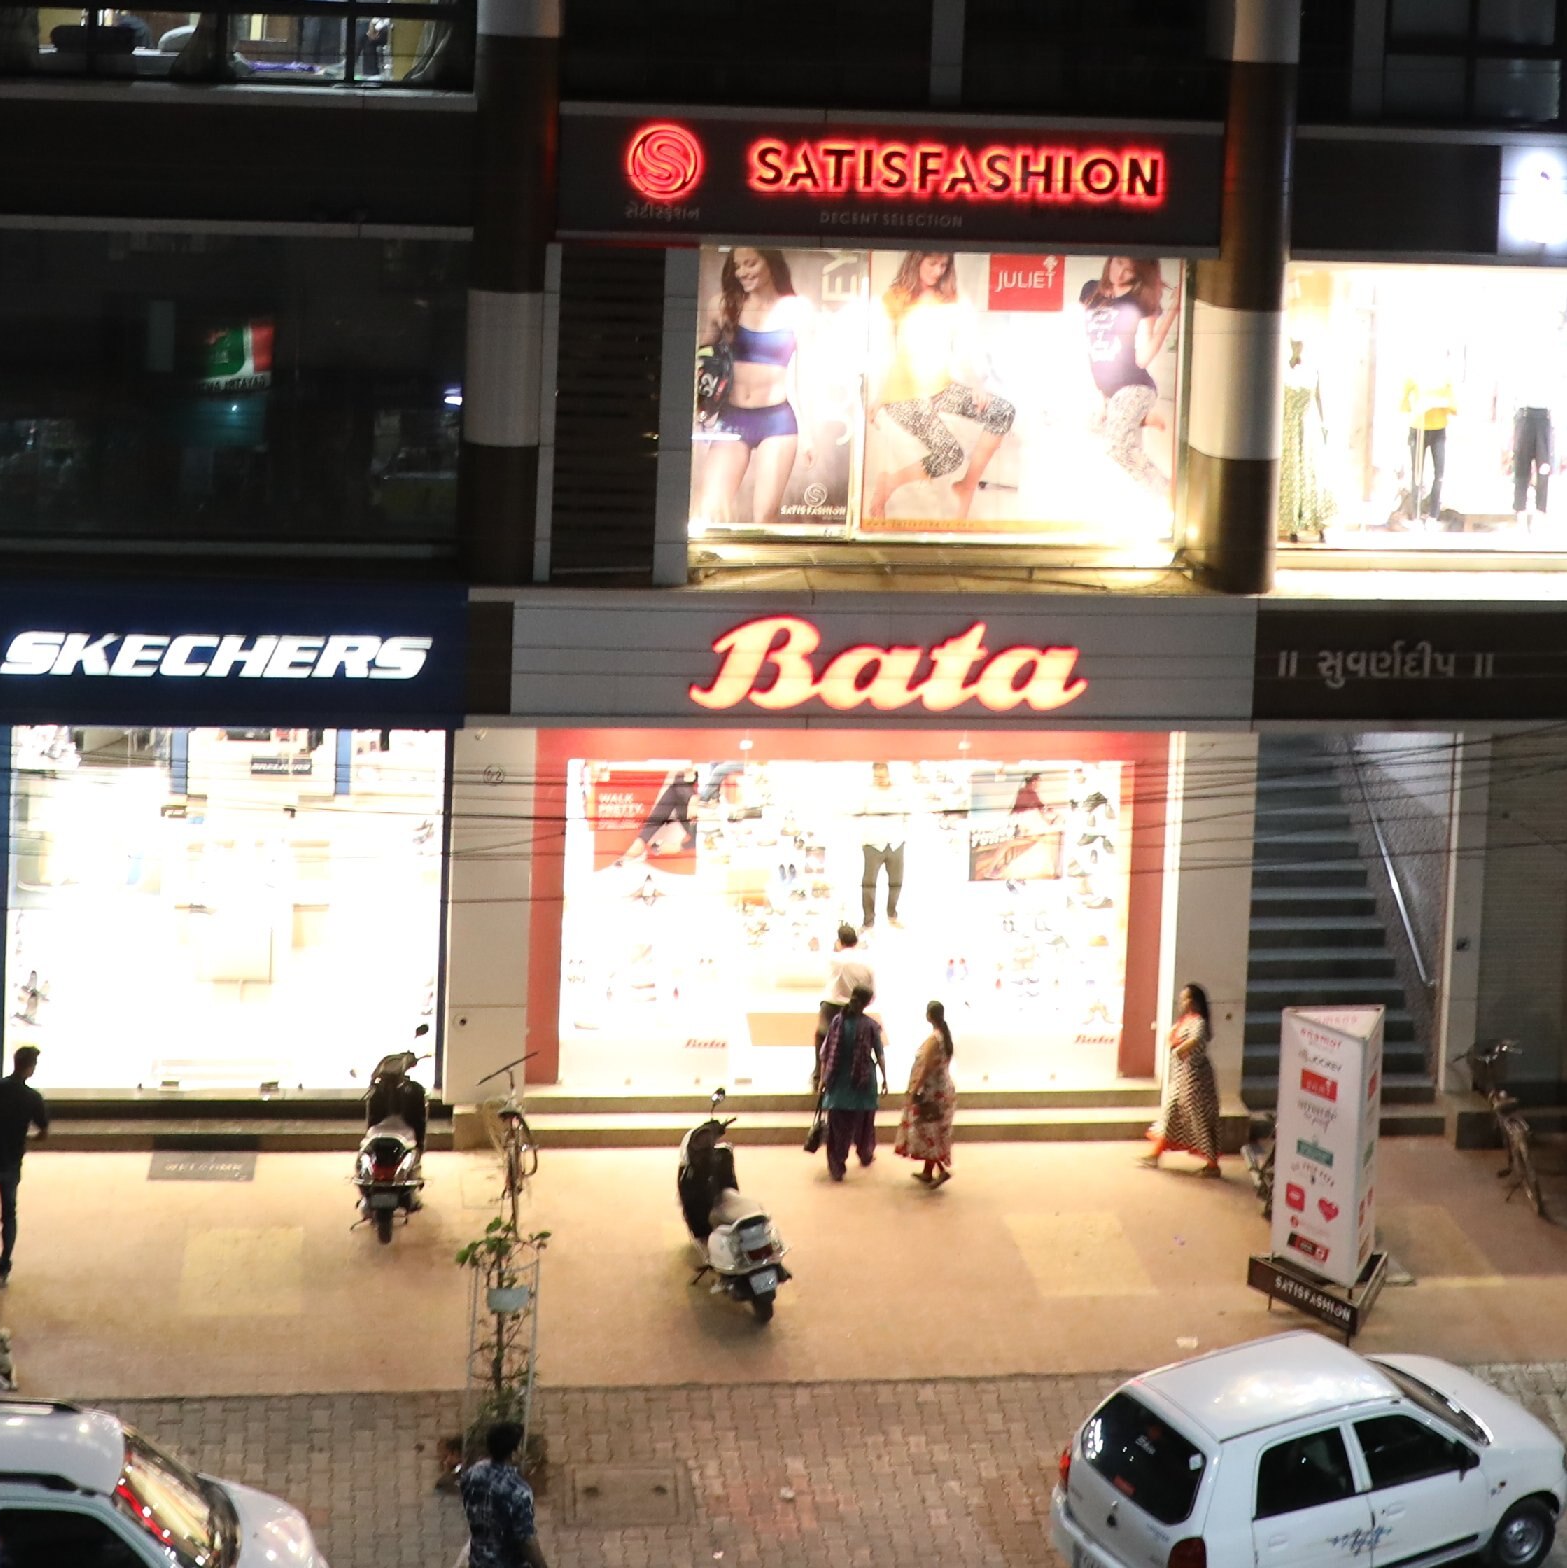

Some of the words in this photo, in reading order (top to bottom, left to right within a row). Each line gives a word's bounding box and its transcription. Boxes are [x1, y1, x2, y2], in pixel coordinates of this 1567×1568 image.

[753, 142, 1163, 199] SATISFASHION
[819, 210, 878, 226] DECENT
[882, 212, 964, 228] SELECTION
[993, 270, 1057, 294] JULIET
[688, 613, 1089, 712] Bata
[1316, 638, 1457, 690] સુવર્ણદીપ
[1274, 1275, 1352, 1322] SATISFASHION
